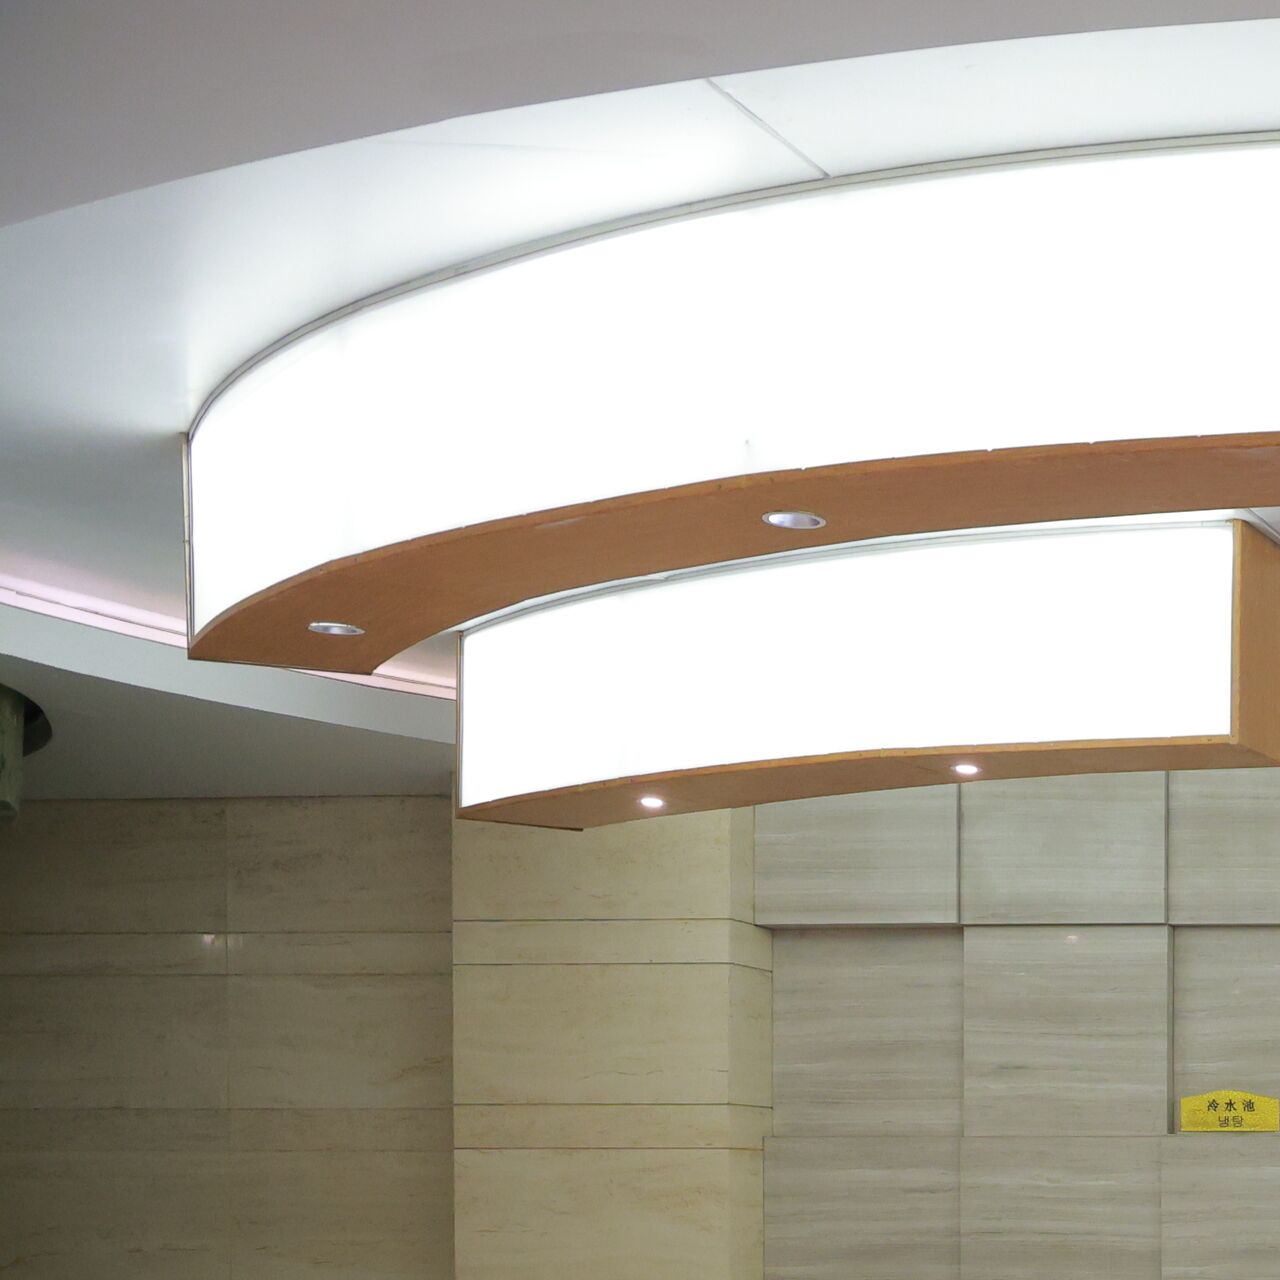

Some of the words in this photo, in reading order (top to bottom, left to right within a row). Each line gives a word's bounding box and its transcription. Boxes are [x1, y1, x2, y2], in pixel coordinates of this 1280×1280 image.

[1207, 1099, 1256, 1112] 冷水池
[1218, 1115, 1244, 1128] 냉탕
